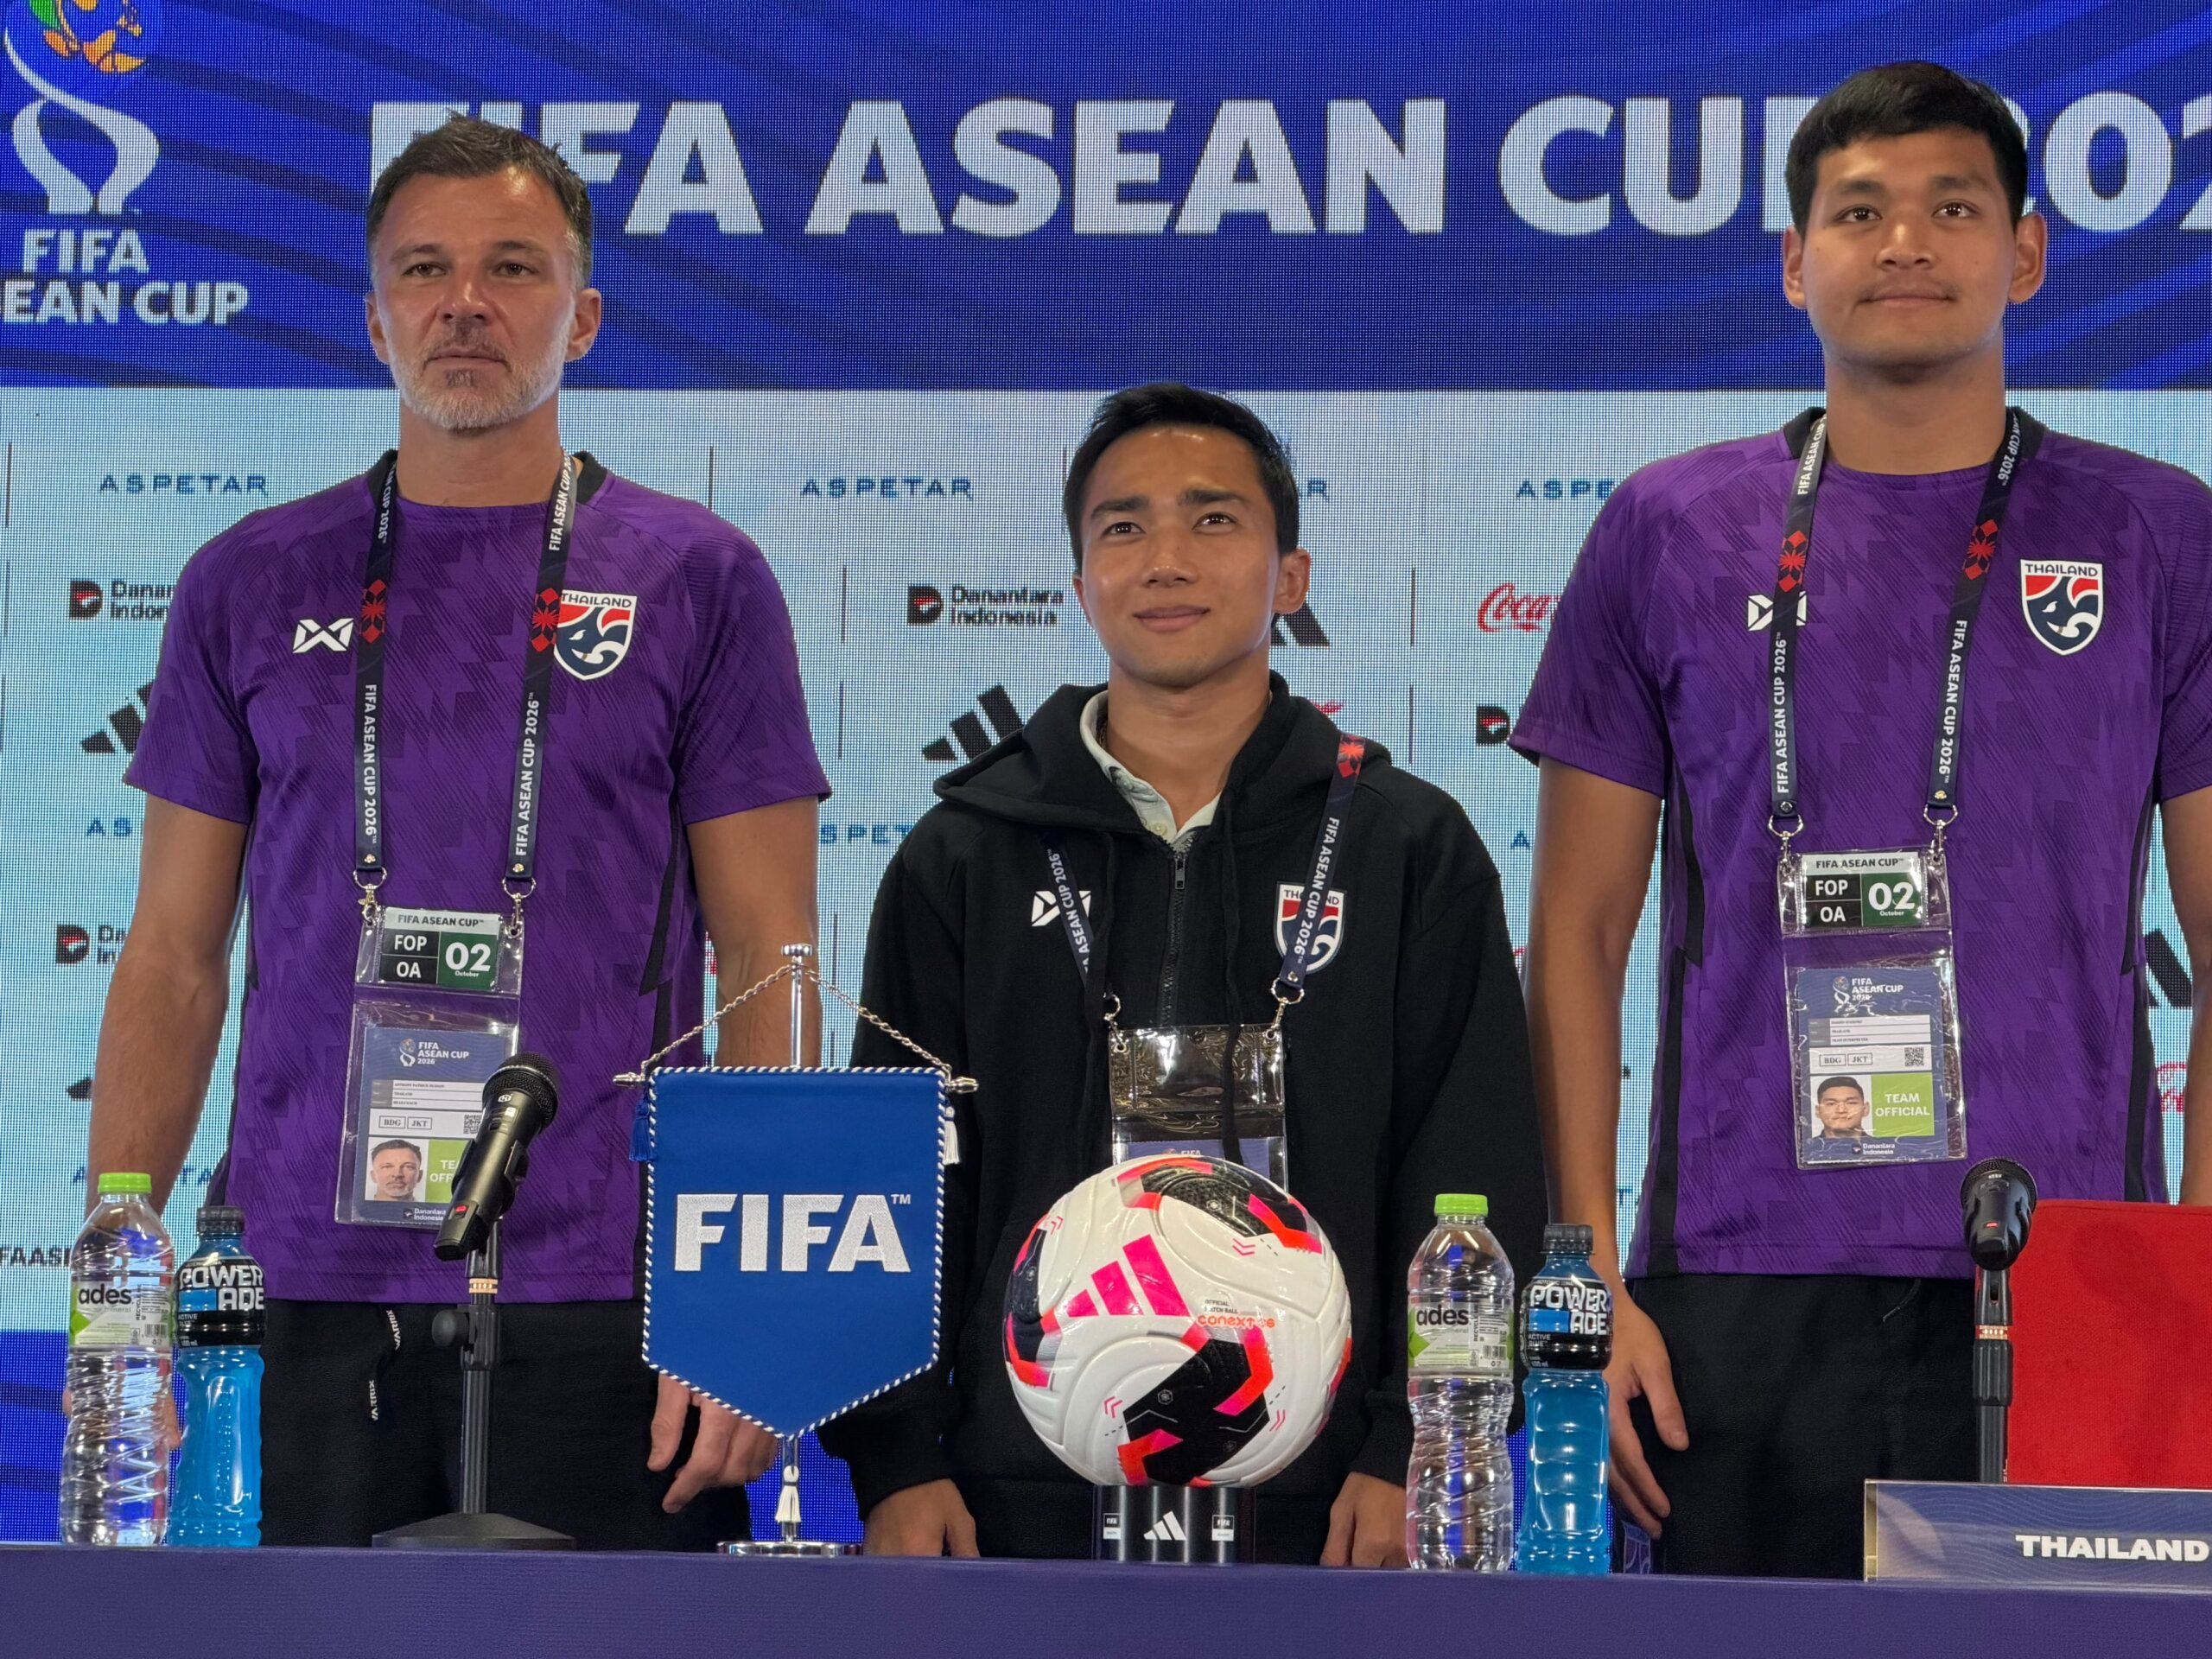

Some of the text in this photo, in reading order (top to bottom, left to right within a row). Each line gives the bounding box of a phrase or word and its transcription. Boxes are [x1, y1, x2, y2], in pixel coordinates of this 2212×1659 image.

[804, 97, 1447, 237] ASEAN
[23, 228, 149, 274] FIFA
[3, 280, 249, 325] EAN CUP
[1802, 440, 1821, 473] ASEAN
[99, 474, 269, 497] ASPETAR
[560, 468, 572, 493] CUP
[802, 478, 973, 500] ASPETAR
[1516, 479, 1614, 499] ASPE
[1797, 473, 1812, 495] FIFA
[554, 491, 569, 526] ASEAN
[549, 528, 563, 551] FIFA
[2024, 563, 2098, 577] THAILAND
[561, 593, 632, 608] THAILAND
[951, 583, 1064, 604] Danantara
[951, 607, 1057, 625] Indonesia
[1952, 620, 1967, 650] FIFA
[1946, 653, 1961, 703] ASEAN
[365, 684, 378, 714] FIFA
[1774, 677, 1785, 706] CUP
[1942, 706, 1957, 735] CUP
[364, 715, 377, 764] ASEAN
[1776, 708, 1787, 758] ASEAN
[522, 738, 536, 768] CUP
[364, 766, 376, 796] CUP
[1777, 761, 1789, 793] FIFA
[518, 770, 533, 822] ASEAN
[516, 823, 530, 856] FIFA
[1324, 817, 1340, 844] FIFA
[1312, 845, 1334, 890] ASEAN
[1816, 860, 1838, 868] FIFA
[1840, 859, 1876, 868] ASEAN
[1058, 884, 1075, 908] CUP
[1815, 880, 1848, 896] FOP
[1868, 881, 1916, 911] 02
[1304, 891, 1321, 919] CUP
[1820, 906, 1846, 923] OA
[397, 914, 419, 924] FIFA
[422, 916, 456, 925] ASEAN
[394, 935, 427, 951] FOP
[1065, 910, 1090, 954] ASEAN
[445, 942, 491, 972] 02
[397, 962, 422, 978] OA
[1852, 984, 1904, 994] ASEAN CUP
[417, 1049, 469, 1059] ASEAN CUP
[418, 1041, 439, 1050] FIFA
[1885, 1093, 1920, 1103] TEAM
[1875, 1105, 1930, 1116] OFFICIAL
[384, 1118, 428, 1128] BDG JKT
[180, 1265, 264, 1289] POWER
[79, 1283, 132, 1306] ades
[219, 1287, 264, 1311] ADE
[1530, 1285, 1608, 1312] POWER
[1416, 1304, 1470, 1325] ades
[1570, 1312, 1608, 1336] ADE
[2015, 1535, 2209, 1562] THAILAND
